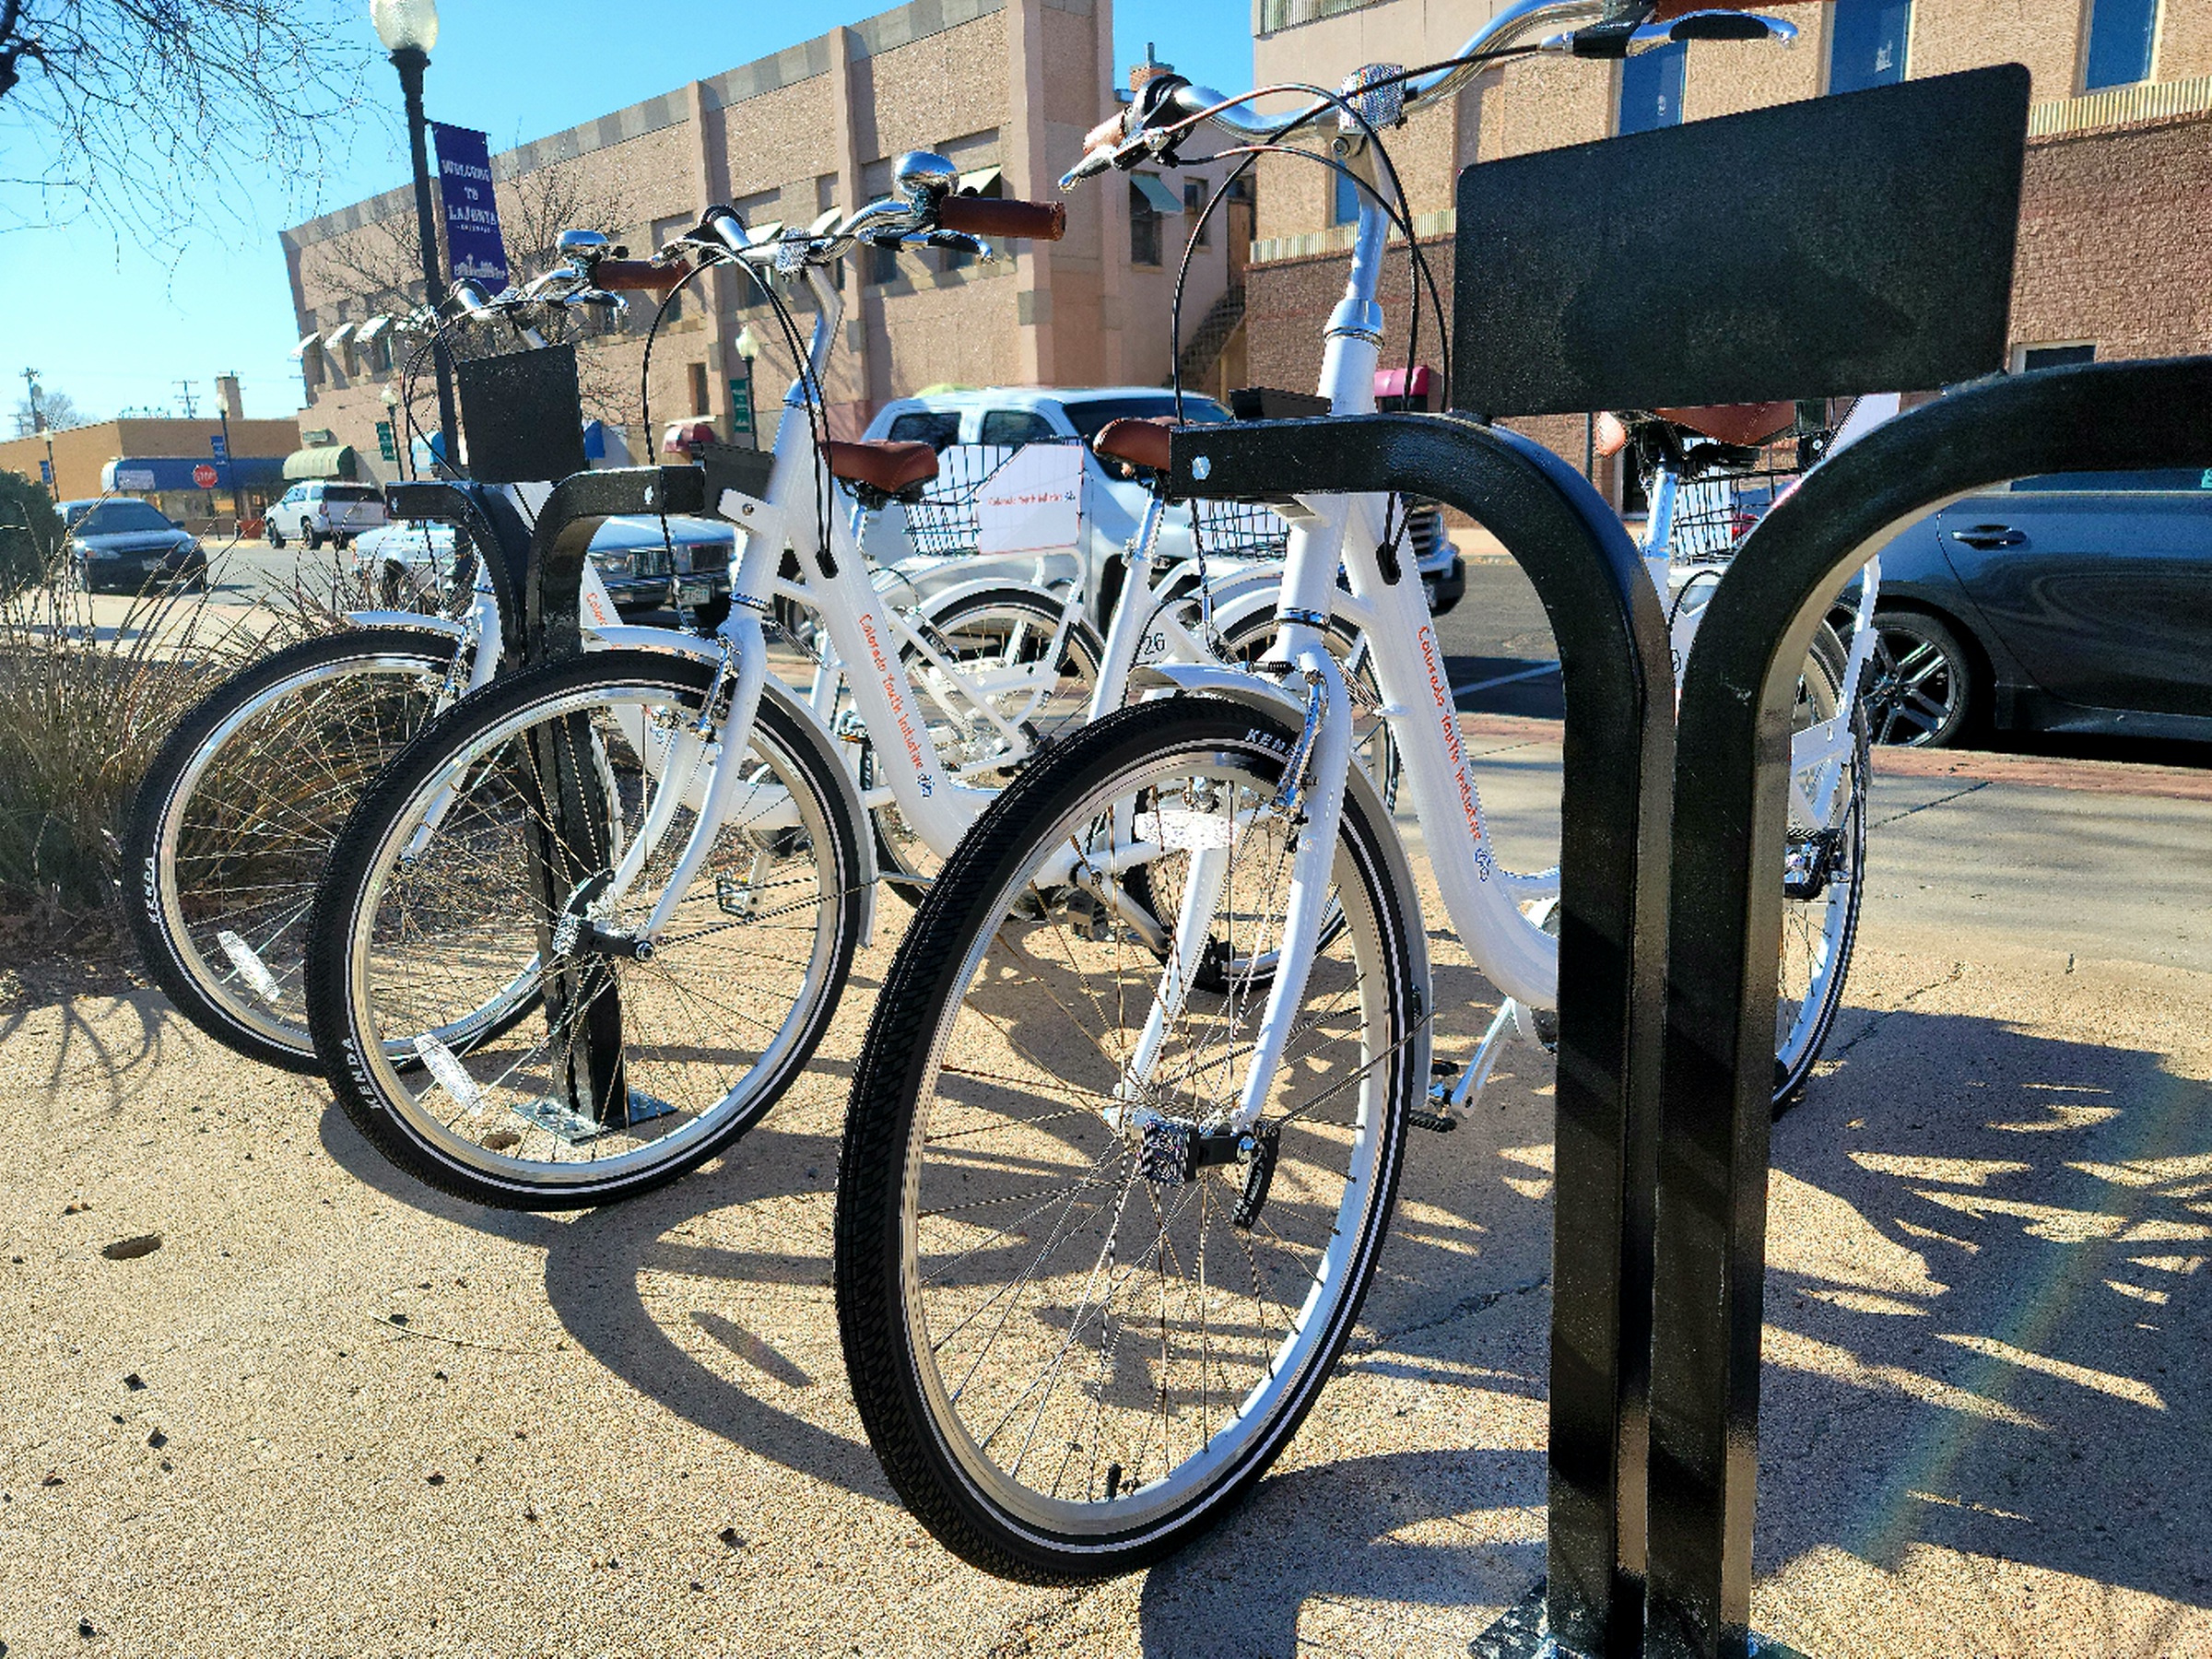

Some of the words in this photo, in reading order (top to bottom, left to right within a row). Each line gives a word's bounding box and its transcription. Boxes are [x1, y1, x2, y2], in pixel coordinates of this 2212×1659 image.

[464, 186, 479, 201] TO
[1144, 632, 1165, 654] 26
[859, 613, 887, 673] Colorado
[882, 673, 904, 714] Youth
[898, 713, 924, 770] Initiative
[1244, 728, 1292, 756] KEN
[1417, 626, 1445, 707] Colorado
[1440, 708, 1462, 765] Youth
[1455, 767, 1481, 841] Initiative
[341, 1038, 382, 1109] KENDA
